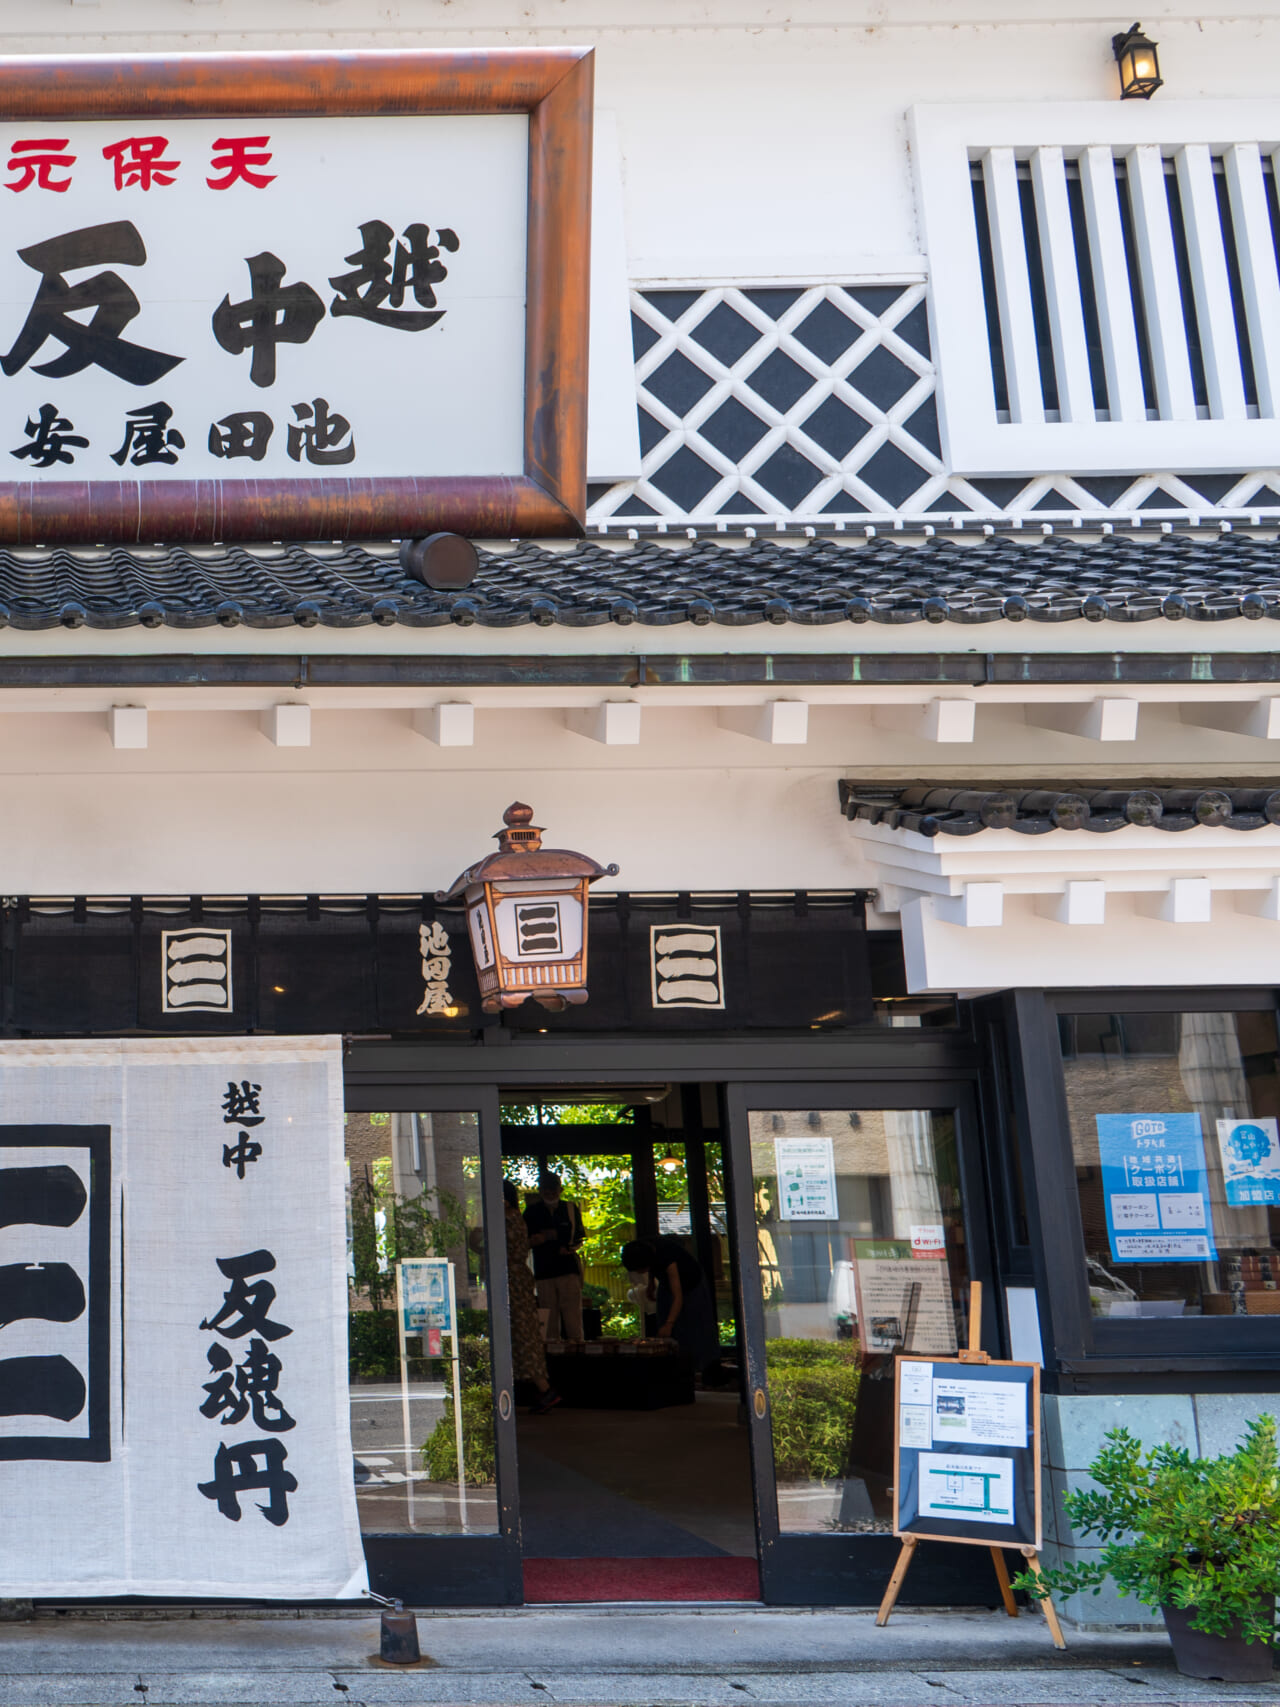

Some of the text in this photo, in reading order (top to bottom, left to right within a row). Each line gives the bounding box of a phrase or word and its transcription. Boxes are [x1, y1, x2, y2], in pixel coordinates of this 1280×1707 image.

[416, 921, 453, 1017] 池田屋
[1136, 1139, 1166, 1149] トラベル
[1130, 1164, 1177, 1175] クーポン
[1132, 1176, 1179, 1187] 取扱店舗
[198, 1080, 299, 1527] 越中 反魂丹
